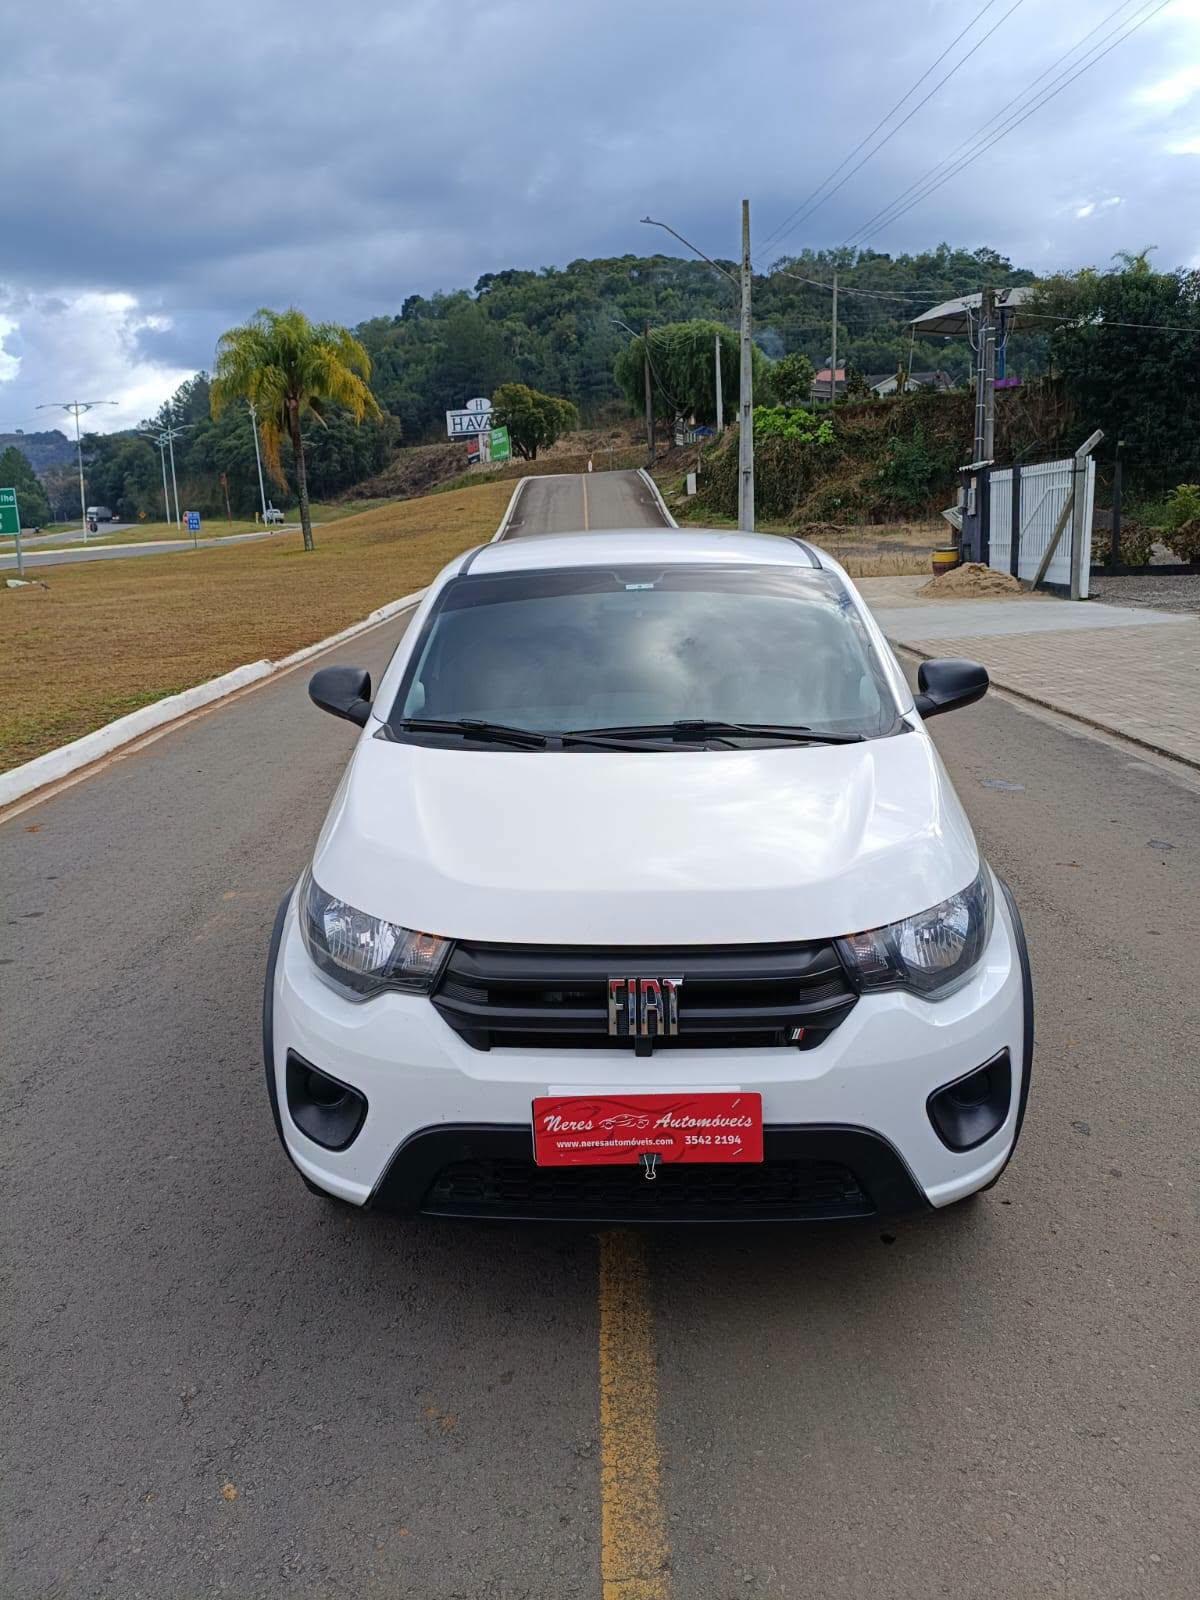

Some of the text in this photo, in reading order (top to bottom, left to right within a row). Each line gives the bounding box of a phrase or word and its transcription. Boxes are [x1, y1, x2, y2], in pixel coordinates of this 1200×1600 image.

[475, 400, 483, 411] H
[608, 978, 683, 1035] FIAT
[543, 1112, 753, 1132] Neres Automóveis
[556, 1135, 742, 1148] www.neresautomóveis.com 3542 2194
